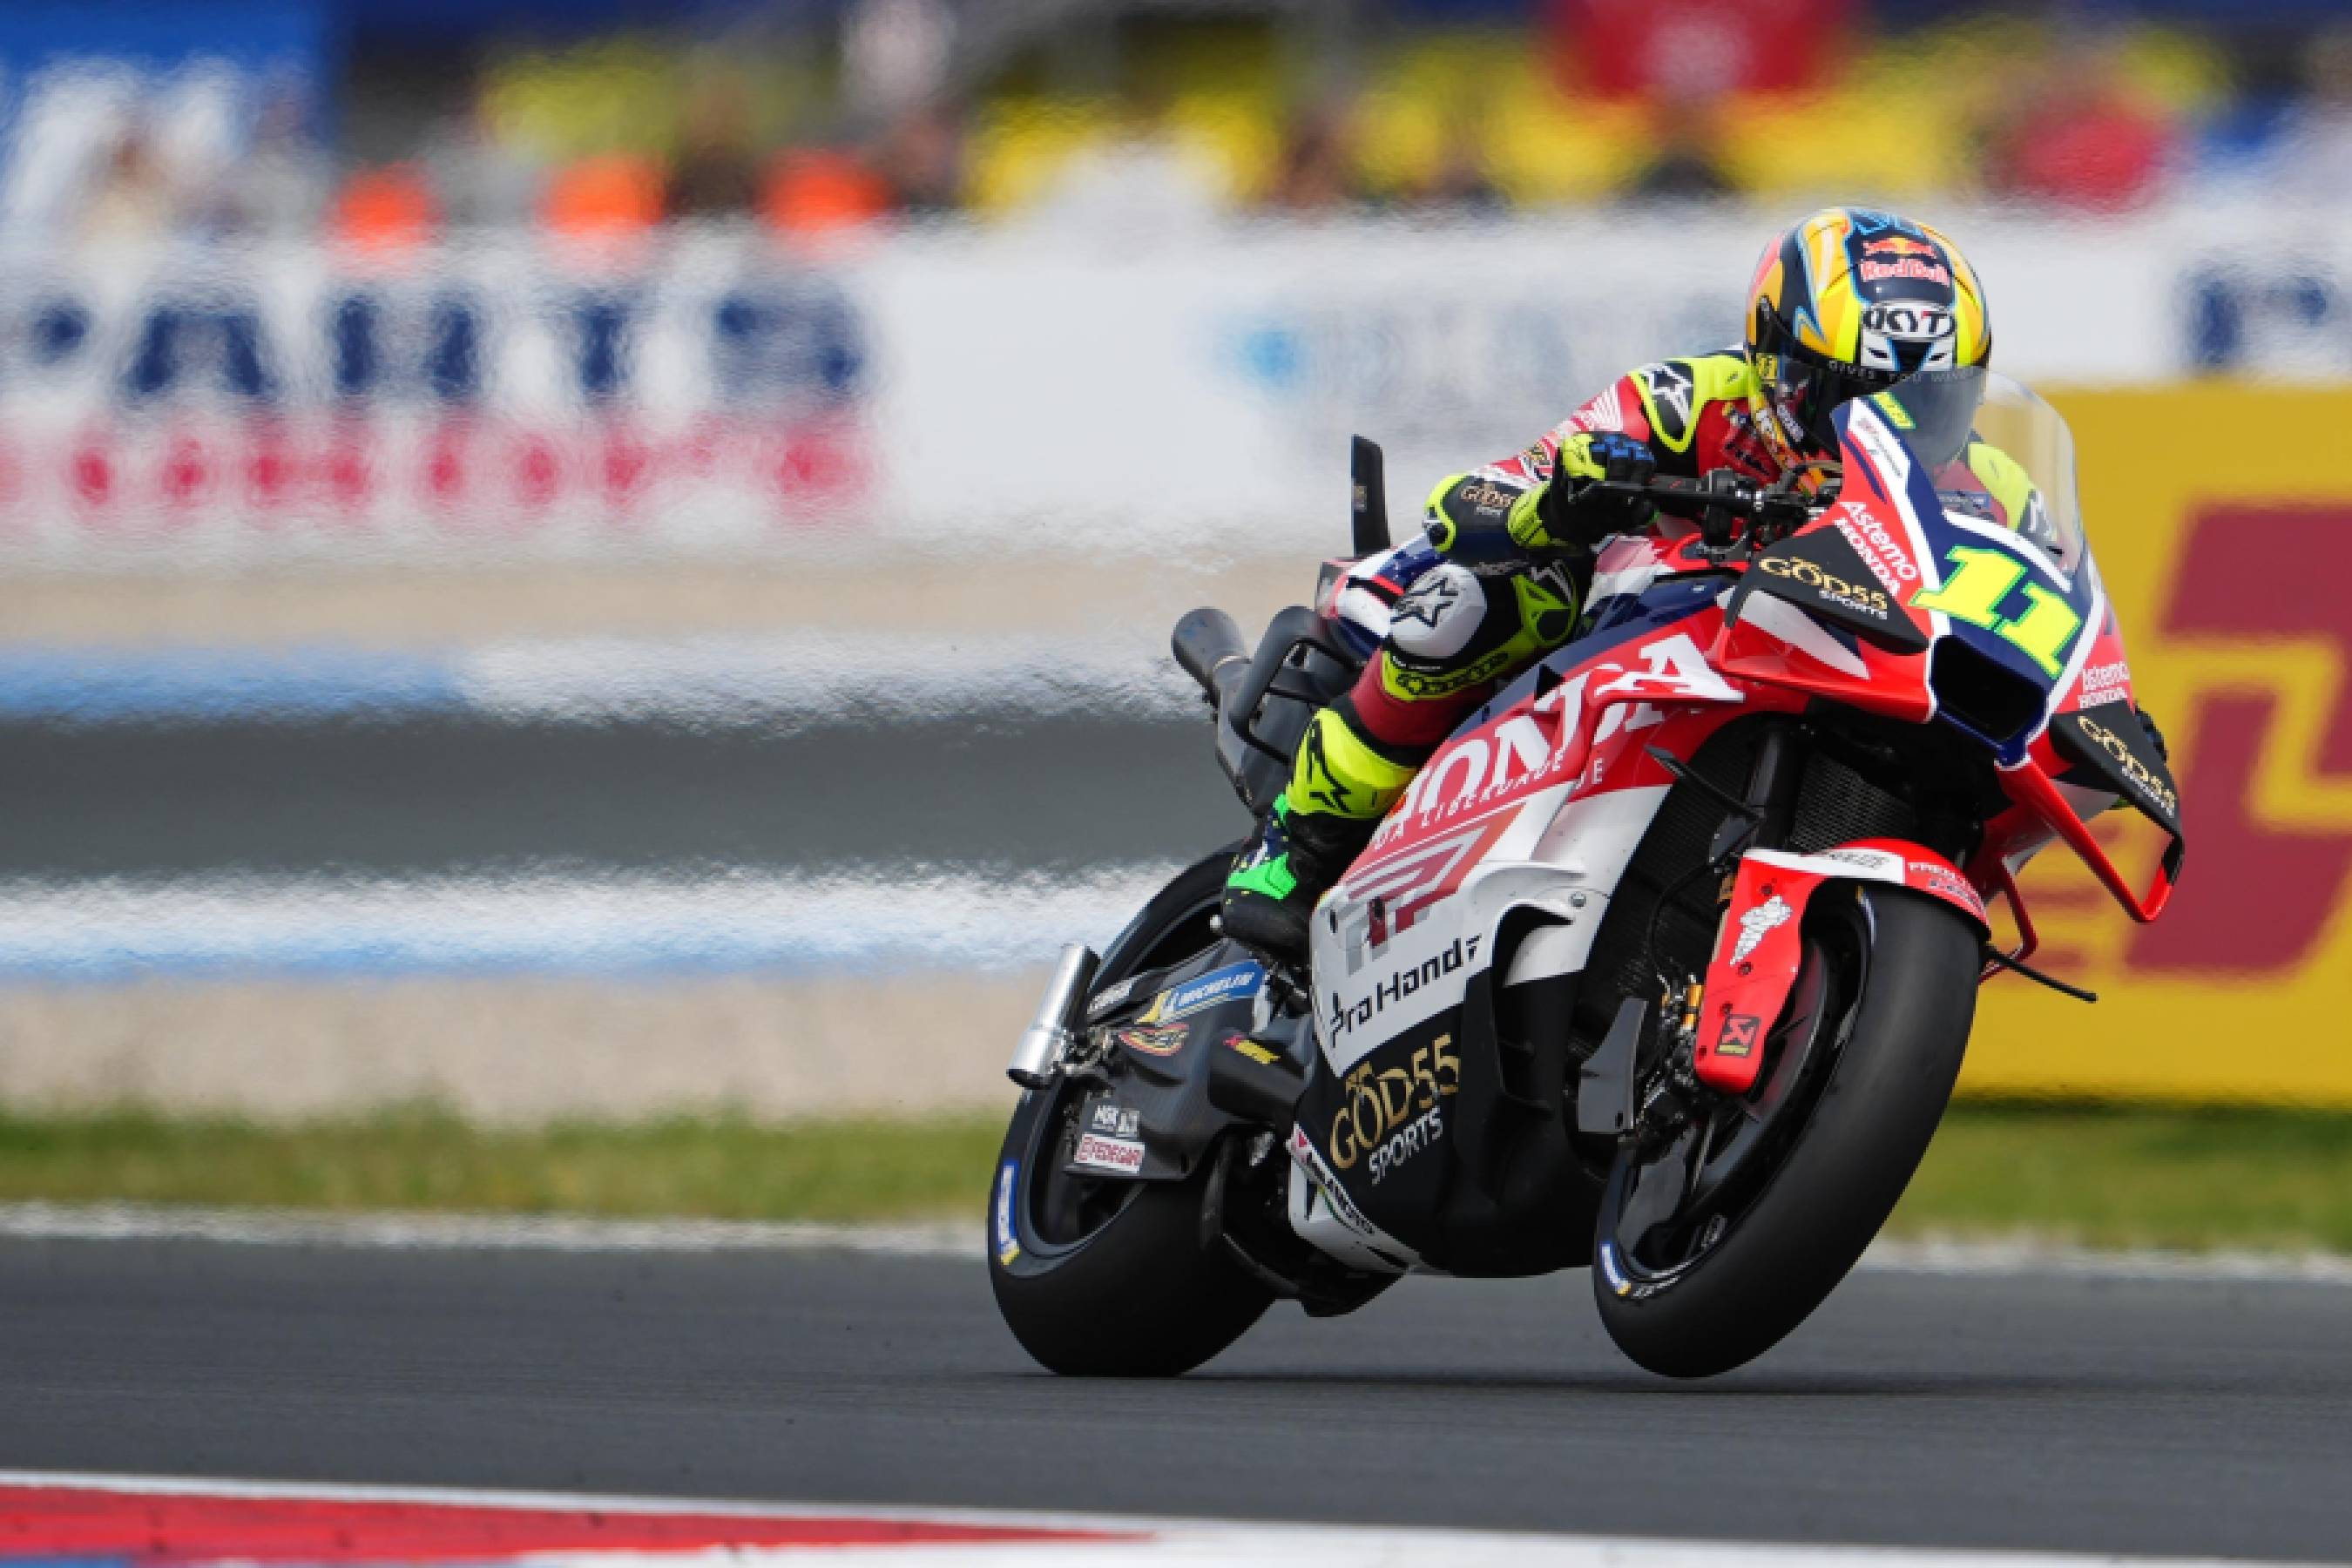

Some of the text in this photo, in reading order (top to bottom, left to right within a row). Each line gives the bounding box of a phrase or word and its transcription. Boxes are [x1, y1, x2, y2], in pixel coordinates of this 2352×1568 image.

[1873, 308, 1949, 336] KYT
[1833, 517, 1901, 597] HONDA
[1837, 501, 1916, 580] Astemo
[1818, 589, 1888, 620] SPORTS
[1909, 544, 2081, 679] 11
[1369, 1105, 1443, 1185] SPORTS
